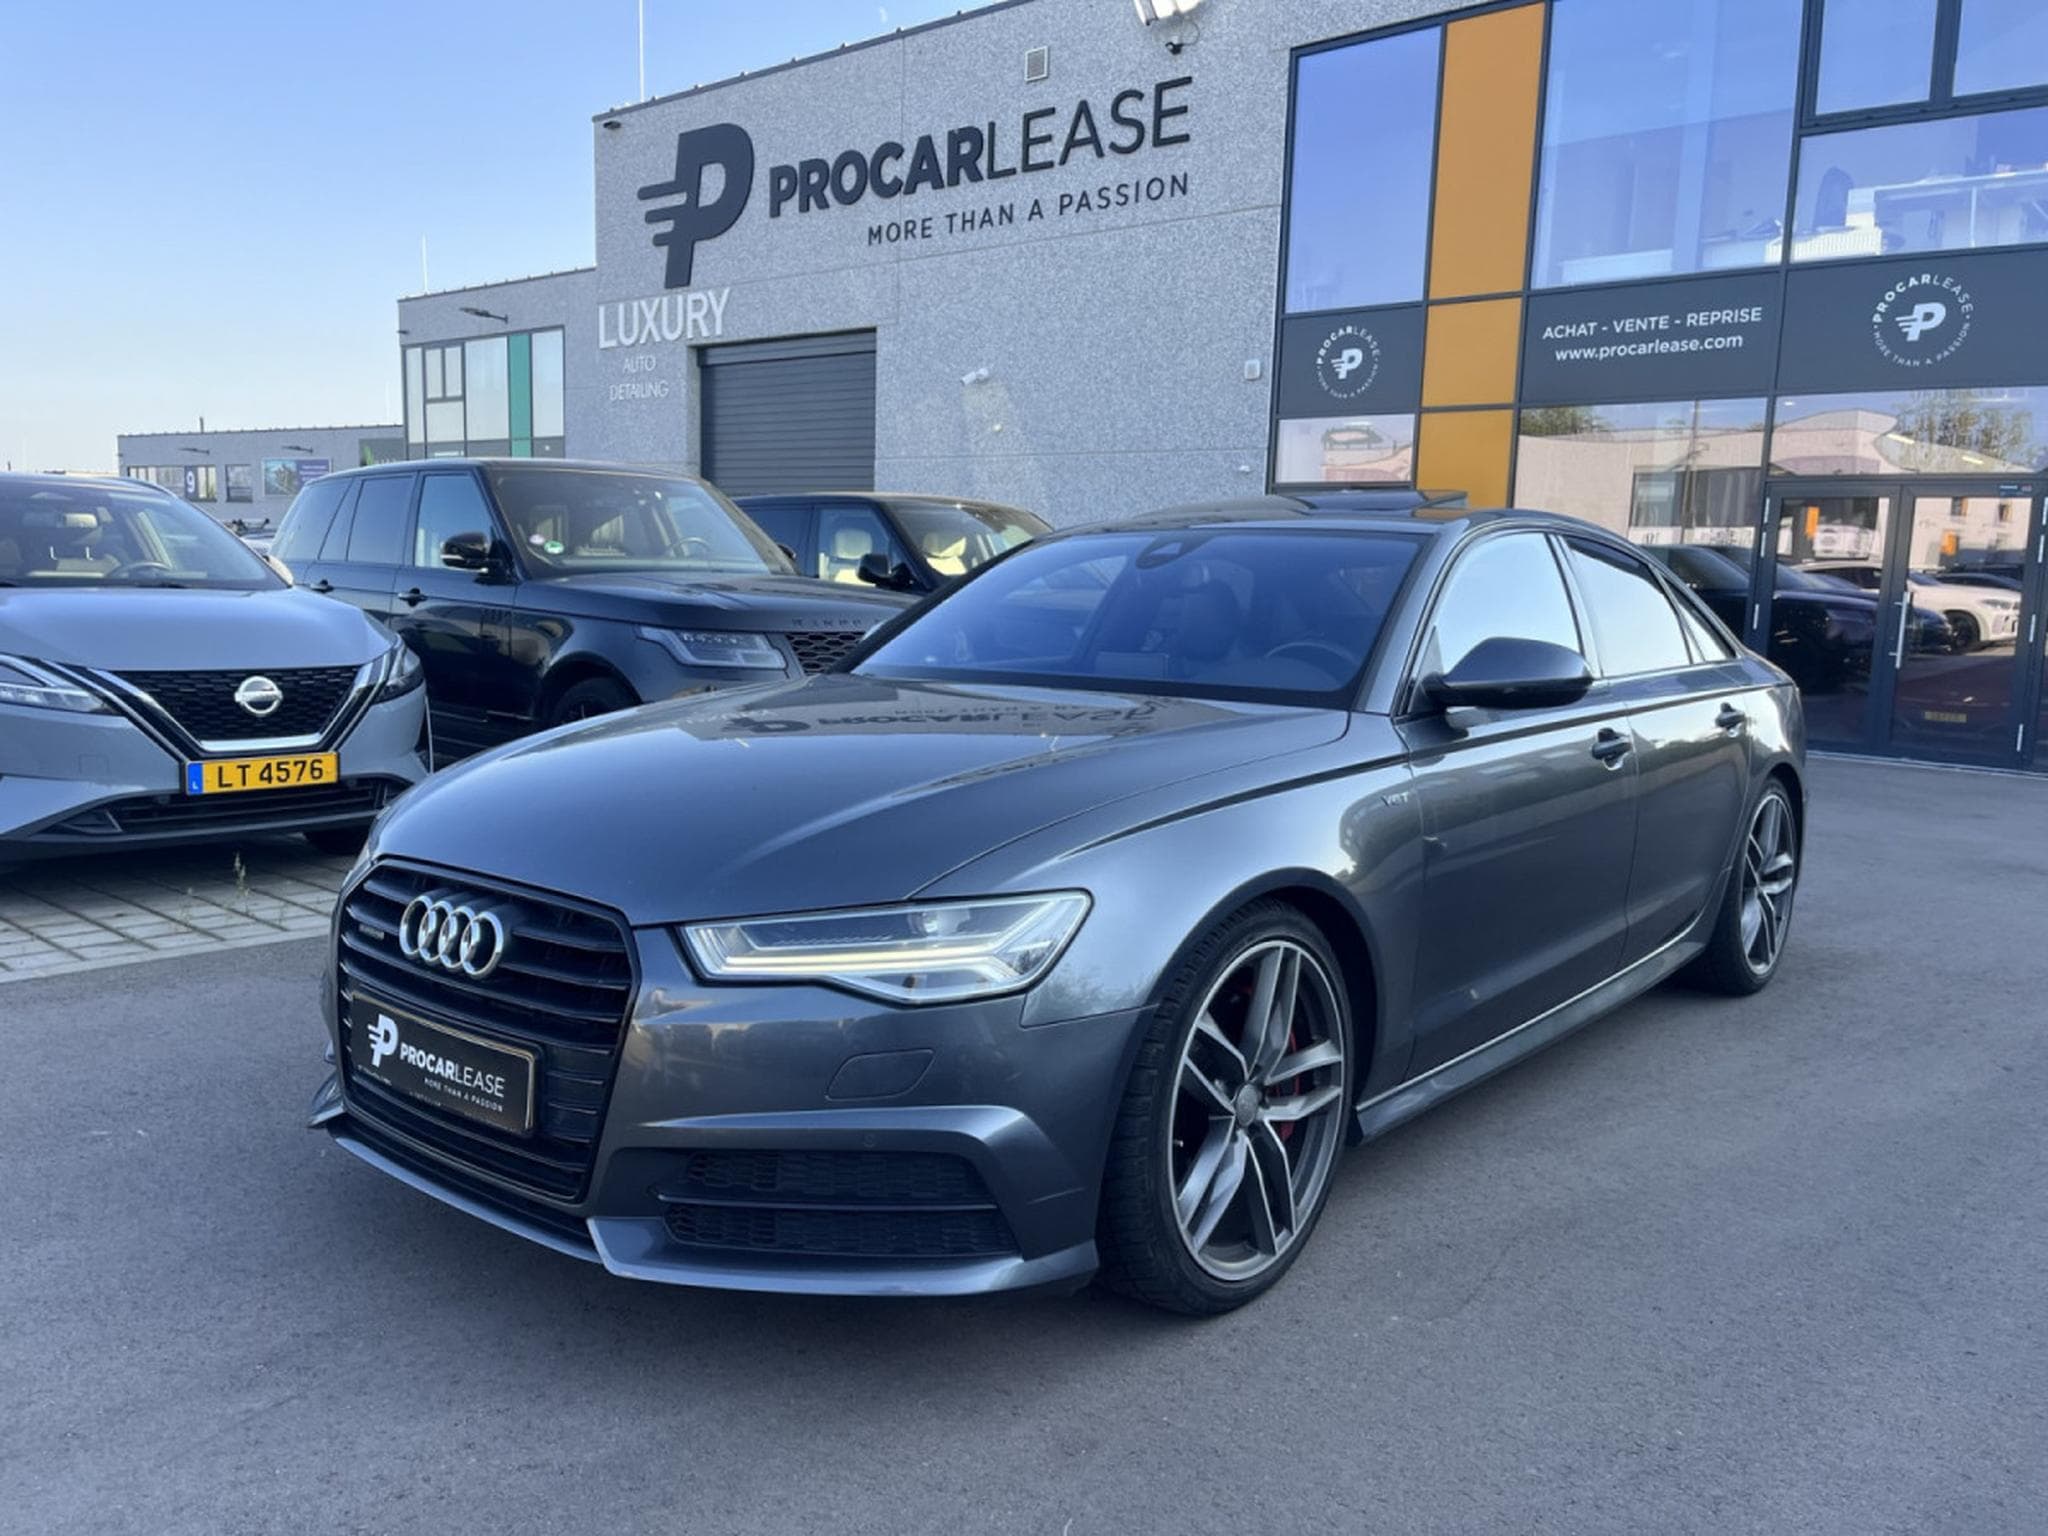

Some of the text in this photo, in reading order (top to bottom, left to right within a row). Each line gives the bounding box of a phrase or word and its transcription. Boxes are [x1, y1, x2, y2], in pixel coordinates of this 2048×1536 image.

[769, 76, 1193, 218] PROCARLEASE
[867, 172, 1189, 246] MORE THAN A PASSION
[1872, 273, 1974, 323] PROCARLEASE
[599, 287, 730, 349] LUXURY
[1543, 322, 1597, 339] ACHAT
[1613, 315, 1670, 333] VENTE
[1686, 307, 1762, 327] REPRISE
[623, 355, 656, 373] AUTO
[1555, 335, 1743, 361] www.procarlease.com
[609, 379, 669, 400] DETAILING
[186, 470, 195, 493] 9
[218, 759, 323, 788] LT 4576
[400, 1043, 505, 1098] PROCARLEASE
[424, 1078, 441, 1091] MORE
[471, 1095, 503, 1112] PASSION
